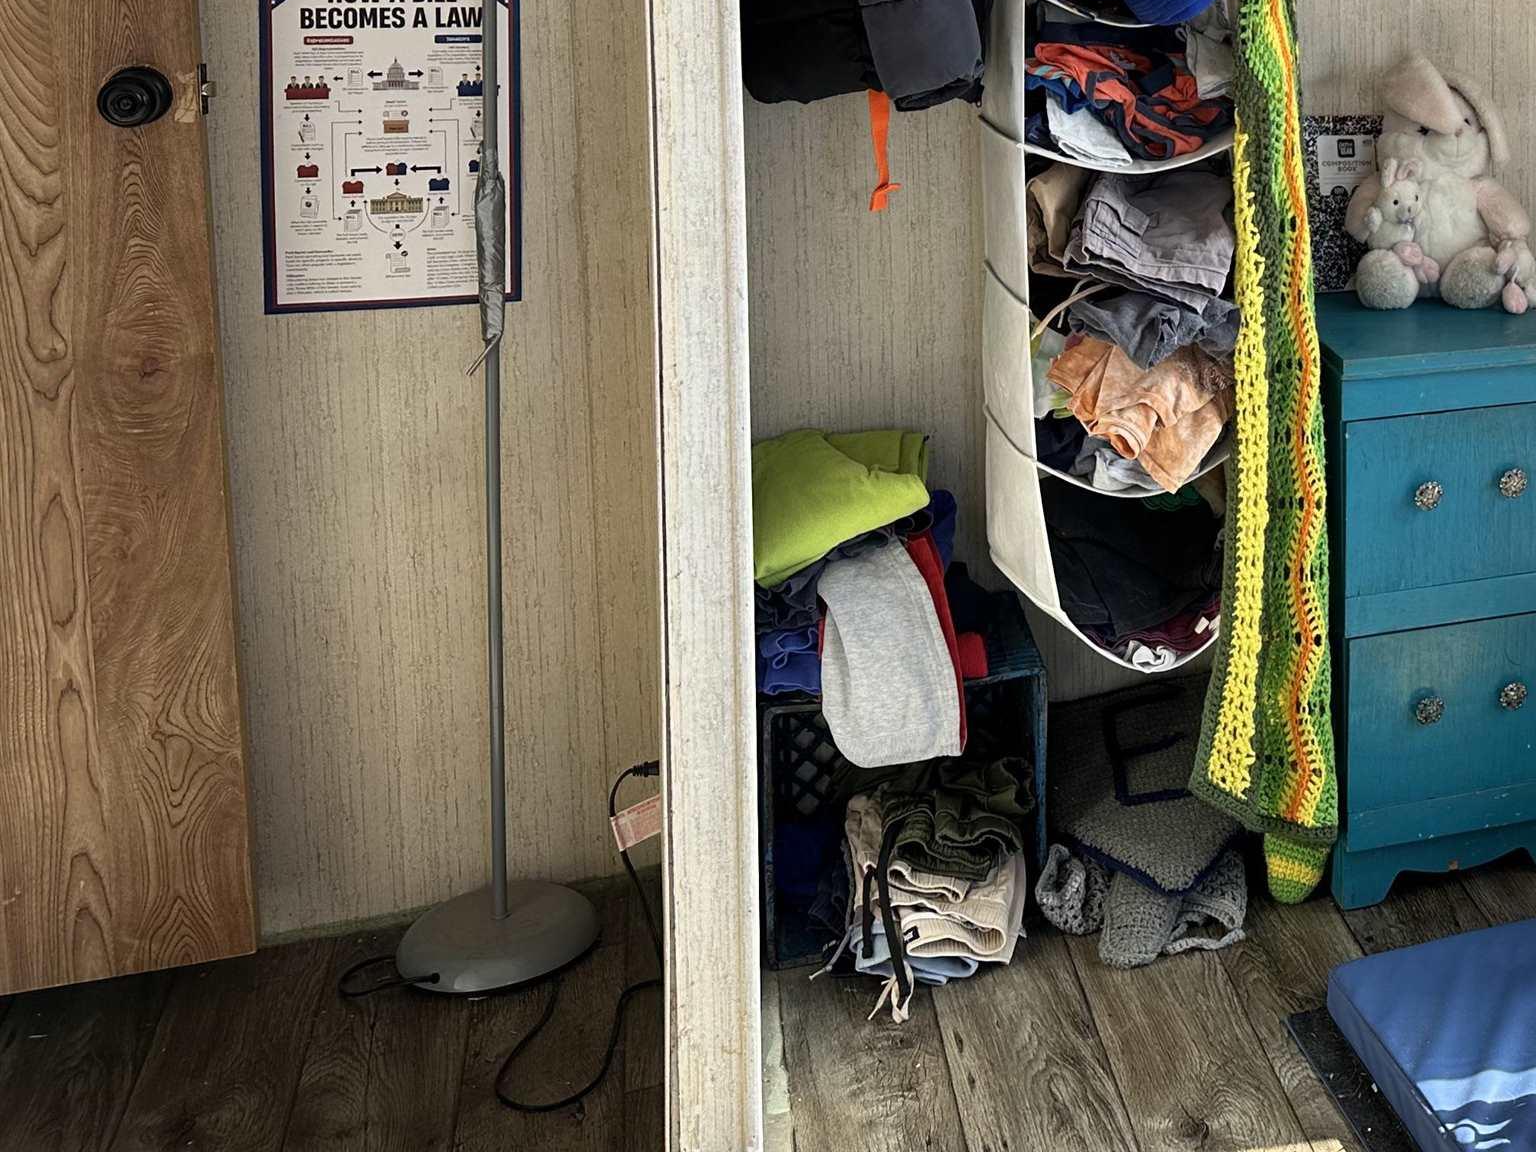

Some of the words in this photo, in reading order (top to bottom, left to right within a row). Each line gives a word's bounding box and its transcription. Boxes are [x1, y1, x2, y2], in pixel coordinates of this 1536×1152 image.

[300, 7, 406, 29] BECOMES
[413, 7, 428, 28] A
[436, 7, 483, 28] LAW
